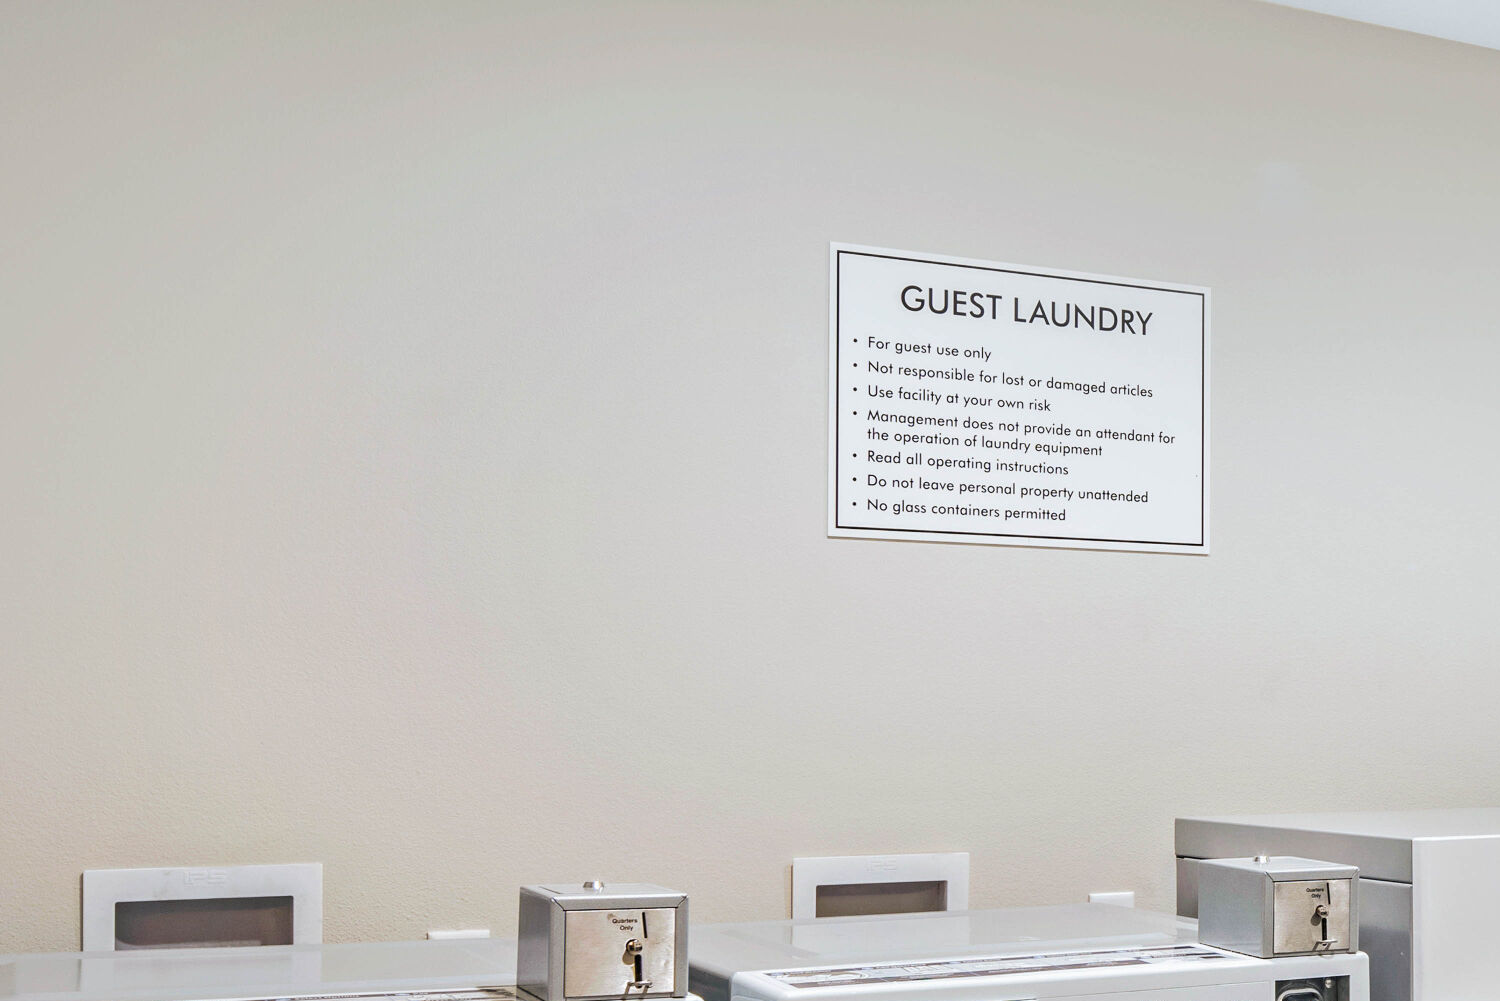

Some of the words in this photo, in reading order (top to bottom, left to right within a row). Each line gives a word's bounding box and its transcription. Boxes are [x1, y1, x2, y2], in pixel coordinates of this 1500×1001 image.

[900, 285, 1002, 320] GUEST
[1014, 297, 1153, 335] LAUNDRY
[868, 336, 890, 350] For
[895, 343, 931, 355] guest
[937, 346, 959, 356] use
[964, 347, 992, 362] only
[868, 361, 893, 374] Not
[898, 366, 975, 382] responsible
[979, 370, 997, 383] for
[1002, 372, 1024, 386] lost
[1029, 379, 1042, 388] or
[1047, 377, 1106, 395] damaged
[1110, 384, 1153, 398] articles
[868, 384, 893, 398] Use
[898, 387, 942, 405] facility
[946, 393, 959, 404] at
[963, 396, 992, 407] your
[997, 399, 1024, 409] own
[1029, 399, 1051, 411] risk
[867, 410, 958, 427] Management
[963, 416, 994, 431] does
[999, 421, 1019, 432] not
[1024, 423, 1071, 436] provide
[1076, 429, 1091, 438] an
[1096, 429, 1155, 443] attendant
[1159, 431, 1175, 444] for
[867, 428, 889, 441] the
[894, 433, 959, 446] operation
[964, 435, 978, 447] of
[982, 436, 1031, 454] laundry
[1035, 442, 1102, 456] equipment
[867, 450, 901, 464] Read
[906, 453, 922, 465] all
[927, 457, 991, 473] operating
[996, 459, 1069, 475] instructions
[867, 474, 887, 487] Do
[892, 478, 914, 489] not
[919, 477, 955, 491] leave
[959, 483, 1015, 495] personal
[1020, 487, 1074, 500] property
[1078, 490, 1148, 503] unattended
[867, 499, 888, 512] No
[892, 500, 927, 514] glass
[931, 504, 1000, 518] containers
[1004, 508, 1066, 521] permitted
